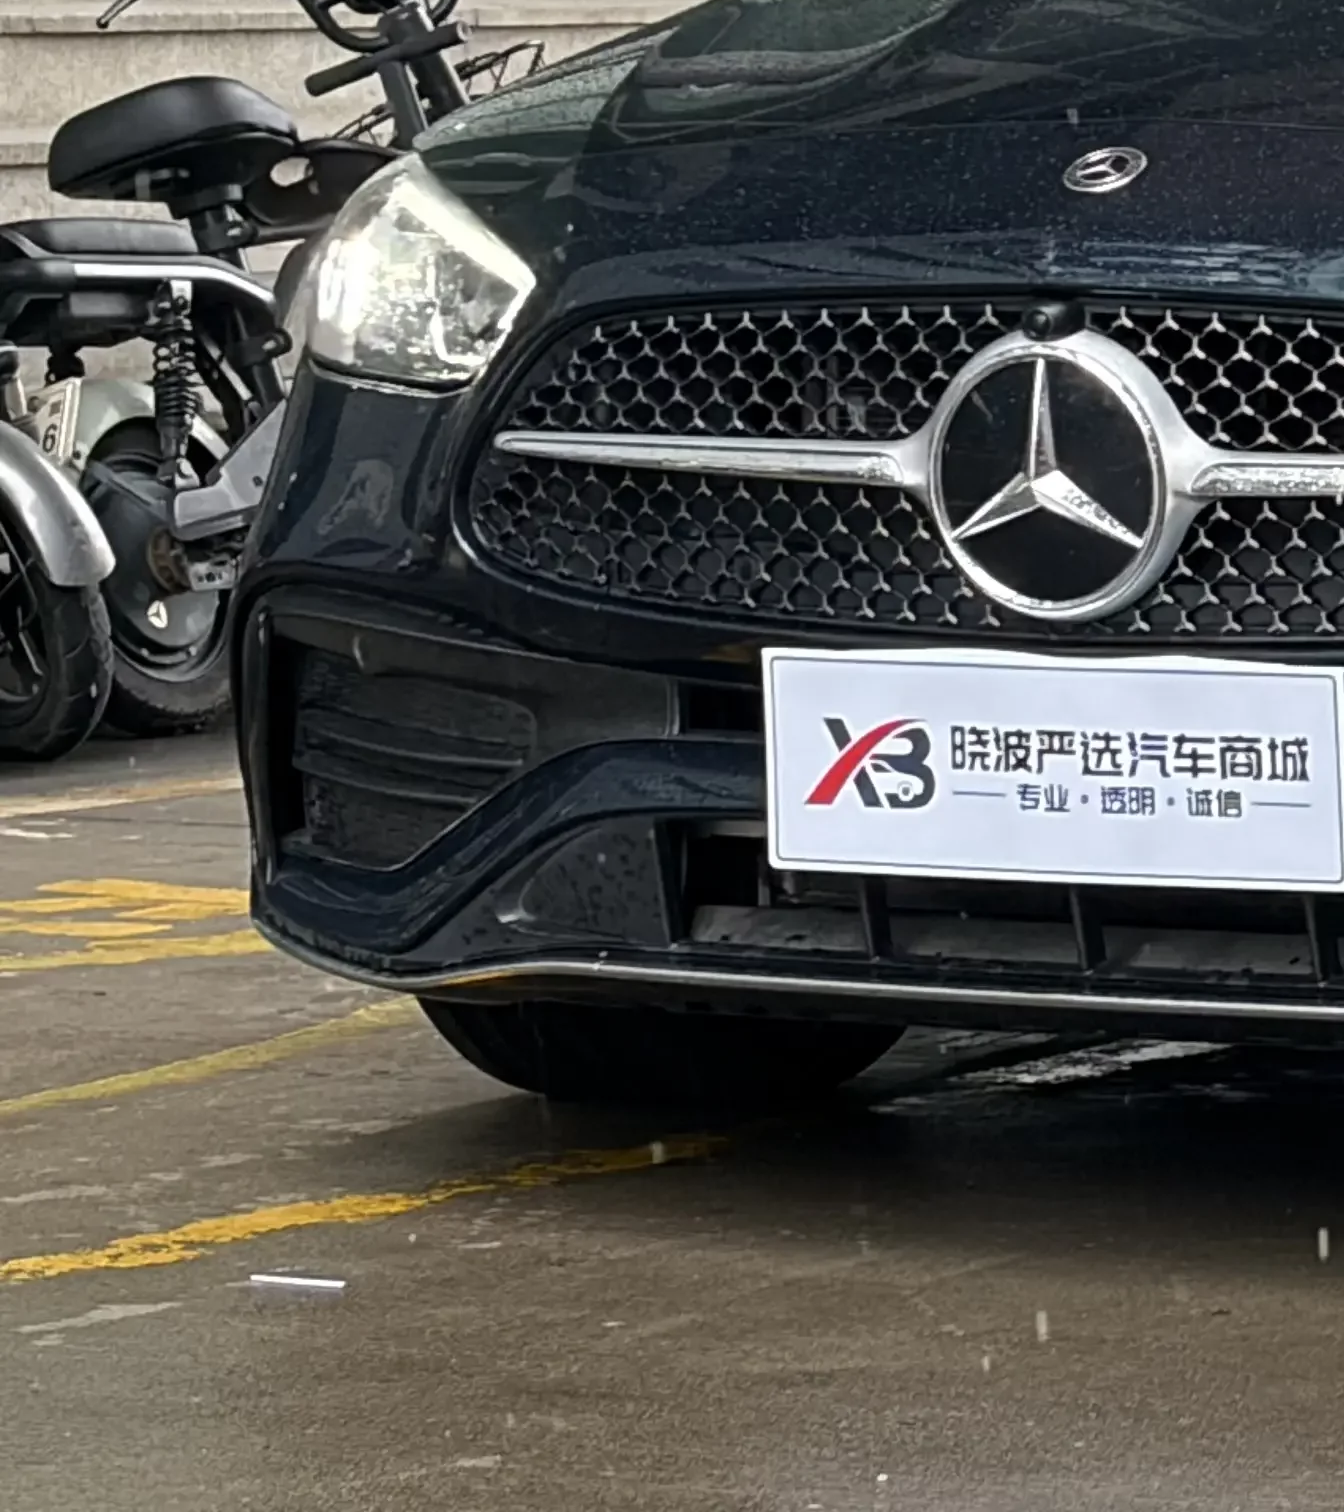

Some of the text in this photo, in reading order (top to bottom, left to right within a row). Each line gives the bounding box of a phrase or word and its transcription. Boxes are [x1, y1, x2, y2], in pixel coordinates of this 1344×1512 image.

[951, 725, 1310, 782] 晓波严选汽车商城
